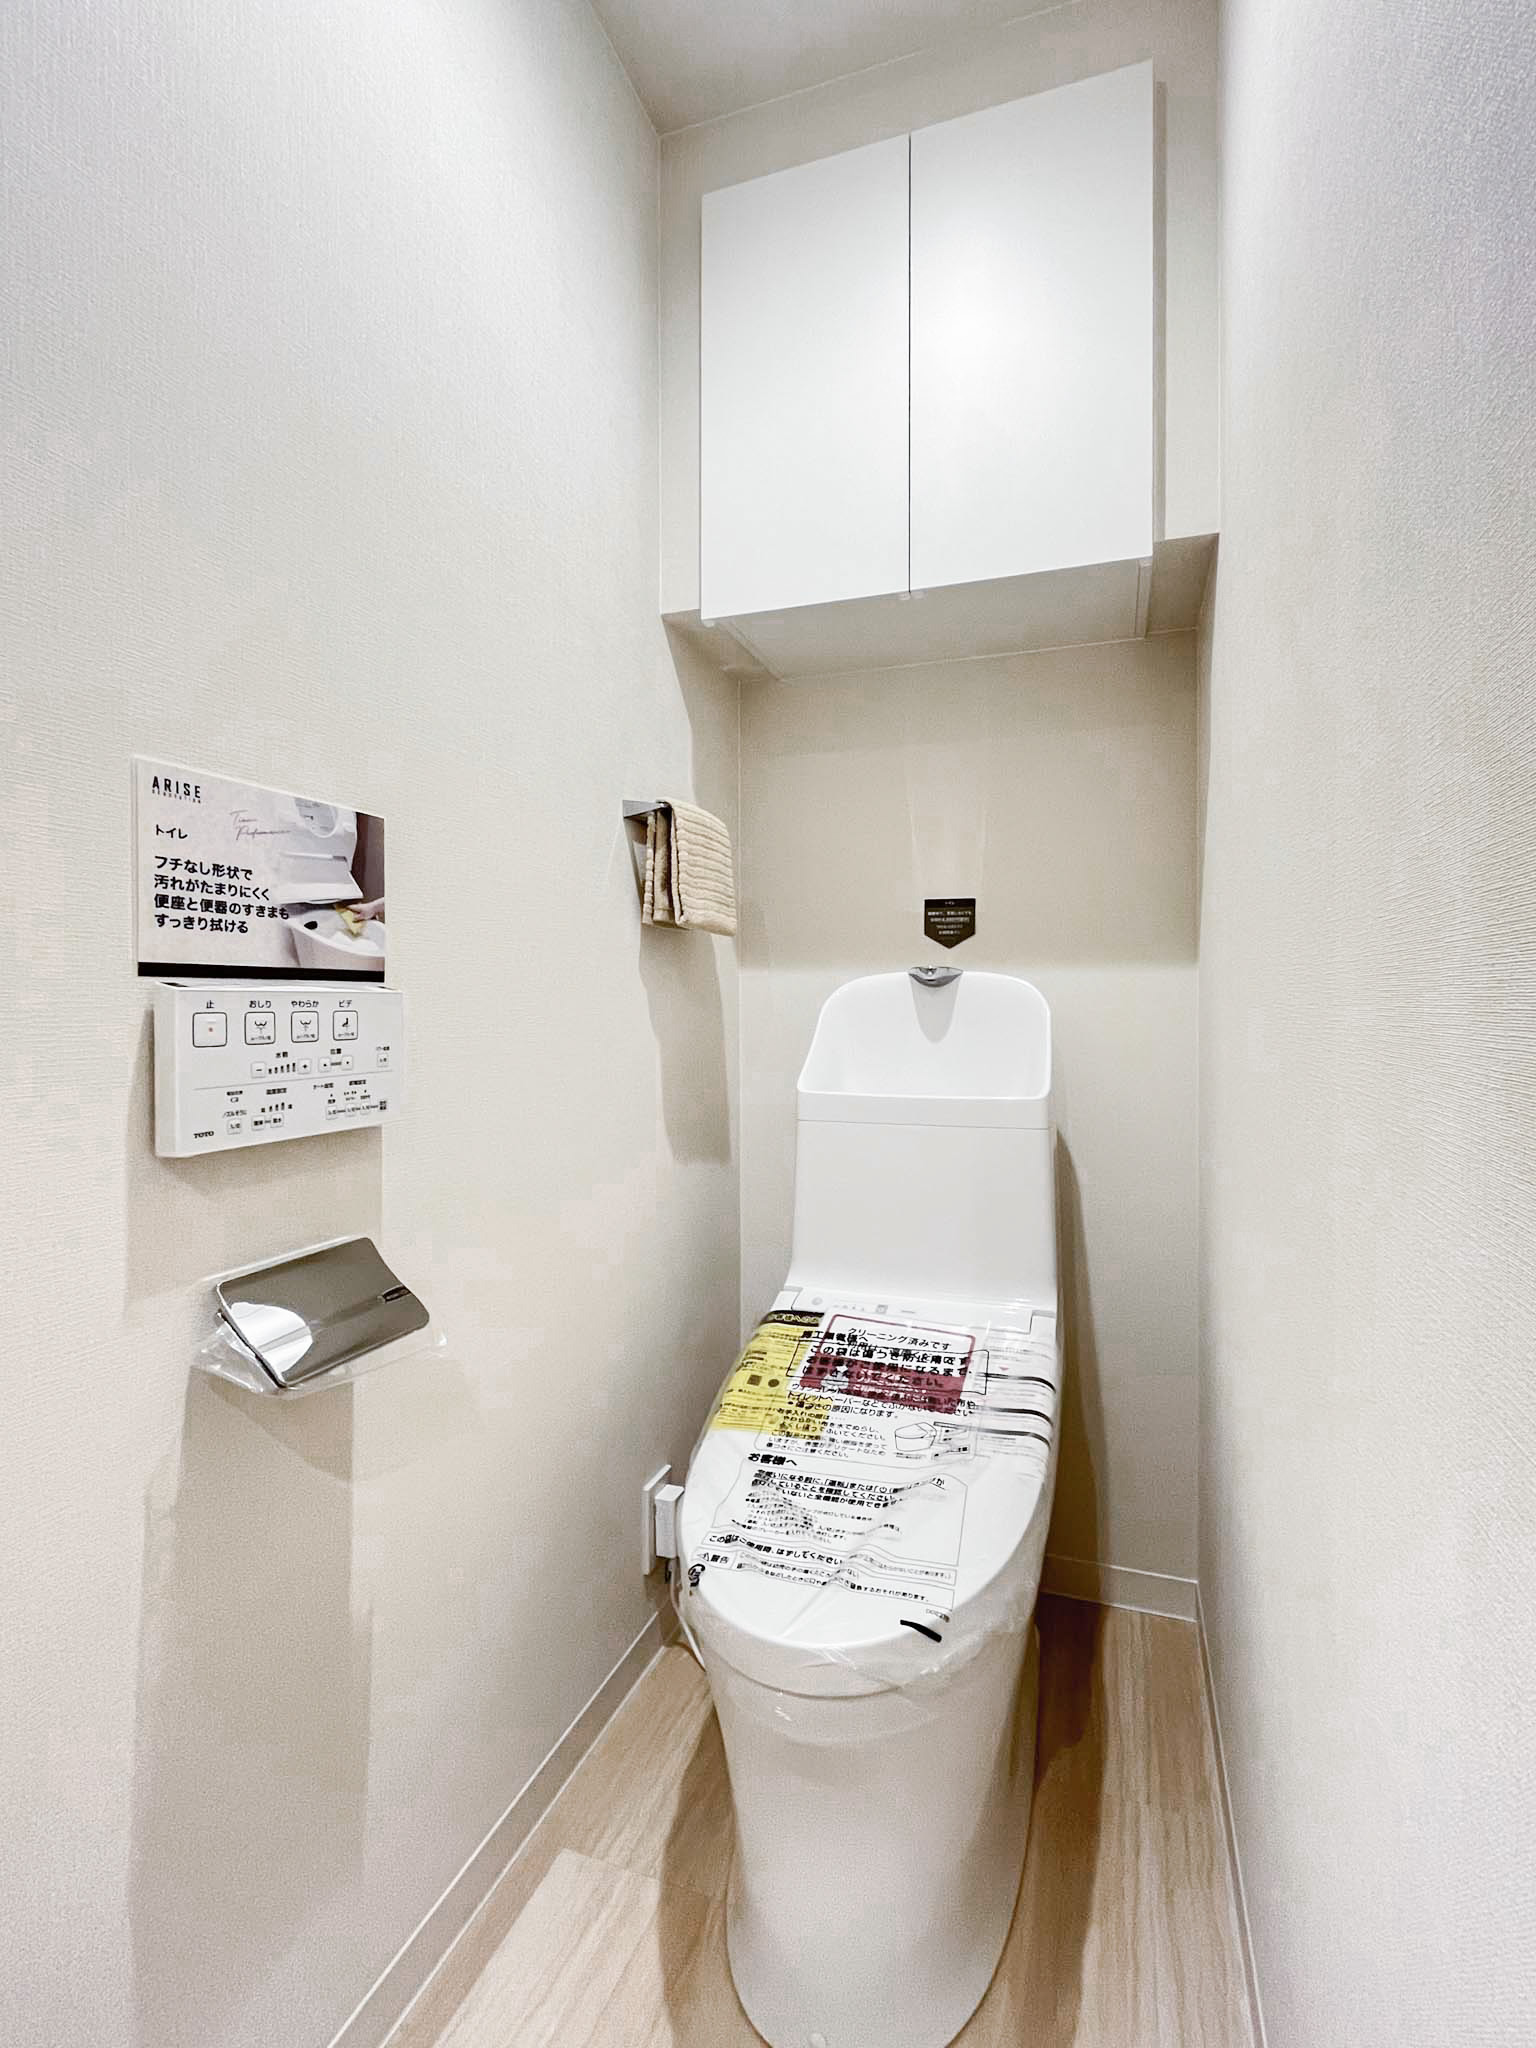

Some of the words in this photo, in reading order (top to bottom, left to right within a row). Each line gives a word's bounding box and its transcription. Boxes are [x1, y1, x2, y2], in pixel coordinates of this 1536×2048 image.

[152, 776, 201, 799] ARISE
[155, 824, 188, 839] トイレ
[154, 855, 253, 881] フチなし形状で
[154, 874, 270, 901] 汚れがたまりにくく
[154, 894, 290, 920] 便座と便器のすきまも
[154, 914, 249, 934] すっきり拭ける
[206, 1000, 215, 1009] 止
[249, 1000, 272, 1009] おしり
[291, 1000, 319, 1008] やわらか
[193, 1130, 215, 1139] TOTO
[849, 1327, 952, 1351] クリーニング済みです
[748, 1453, 798, 1466] お客様へ
